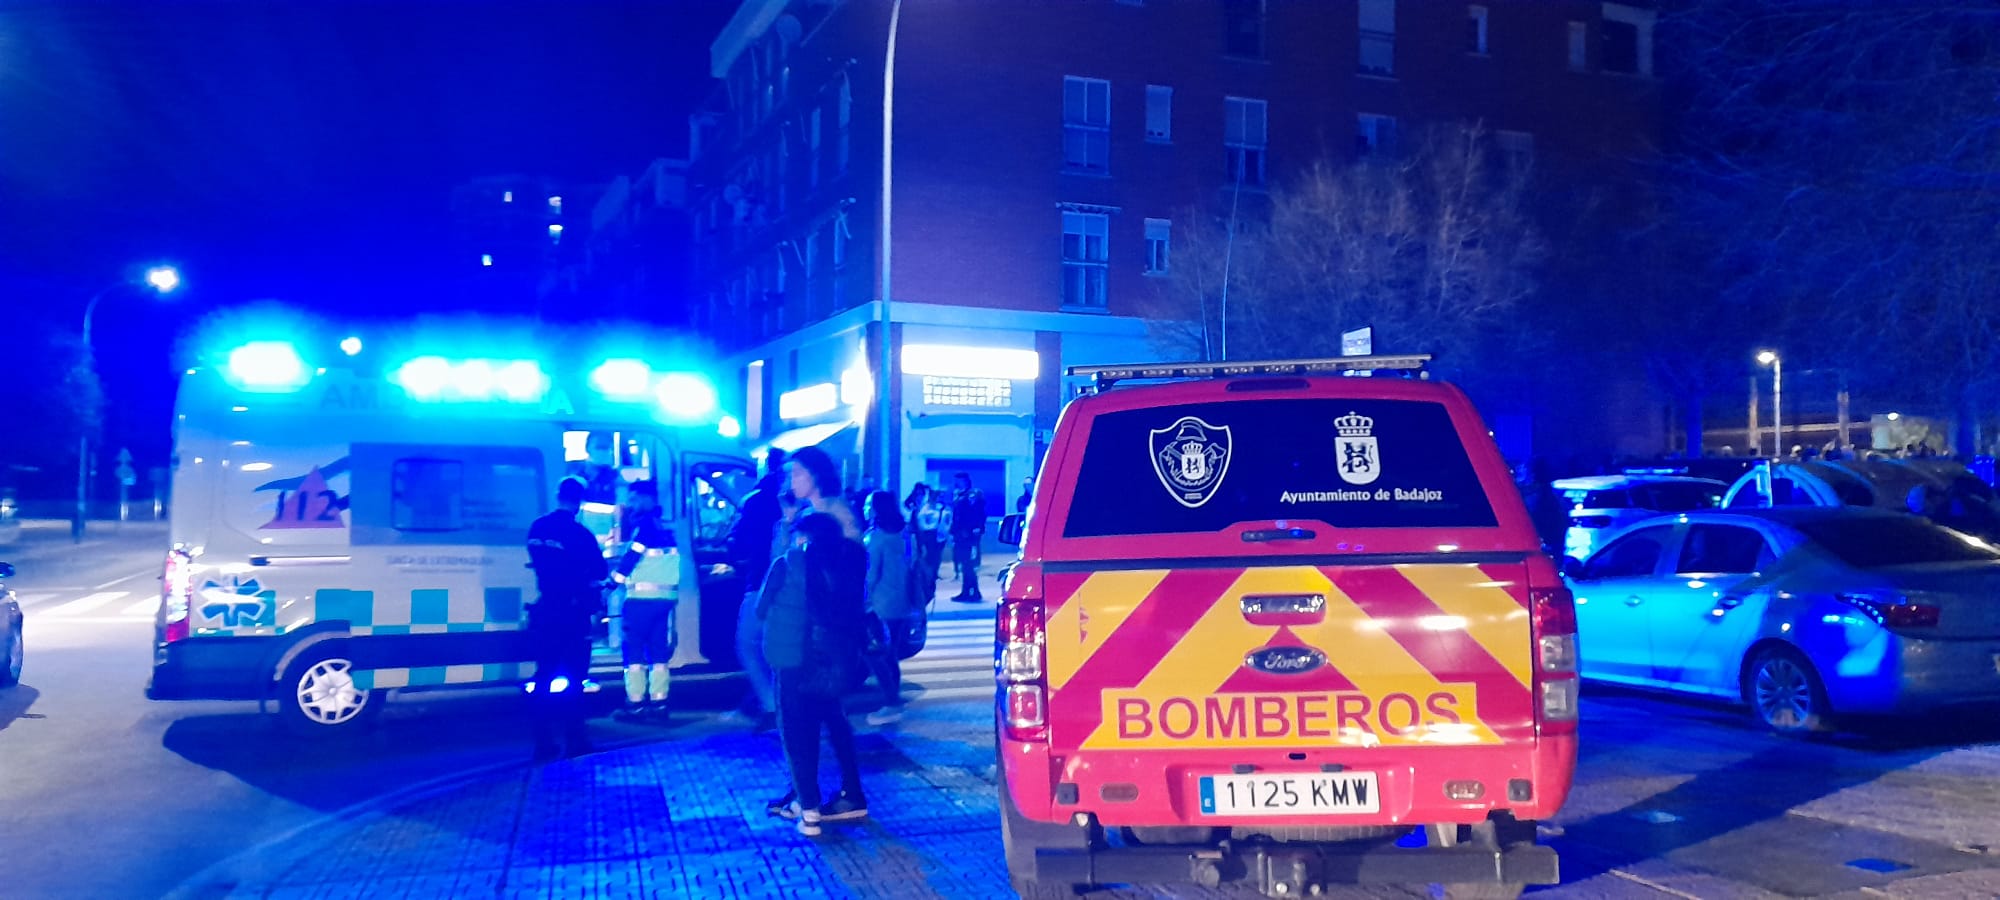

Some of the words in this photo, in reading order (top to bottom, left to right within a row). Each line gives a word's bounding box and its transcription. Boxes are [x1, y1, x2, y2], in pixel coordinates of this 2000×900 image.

[275, 489, 338, 522] 112
[1280, 489, 1371, 504] Ayuntamiento
[1374, 488, 1390, 501] de
[1394, 487, 1443, 503] Badajoz
[1264, 651, 1311, 669] Ford
[1117, 691, 1461, 740] BOMBEROS
[1227, 780, 1299, 808] 1125
[1311, 779, 1368, 807] KMW
